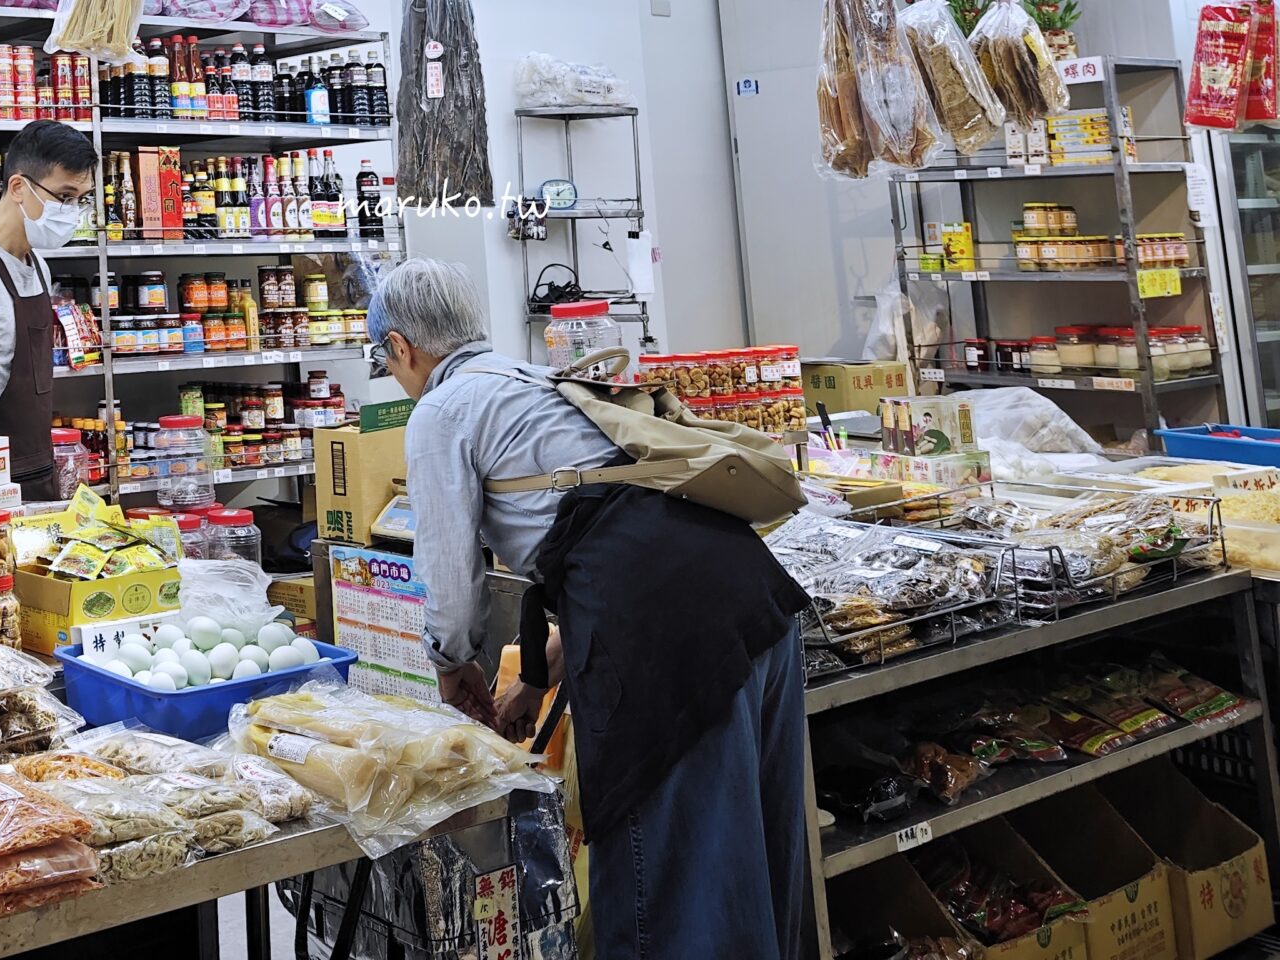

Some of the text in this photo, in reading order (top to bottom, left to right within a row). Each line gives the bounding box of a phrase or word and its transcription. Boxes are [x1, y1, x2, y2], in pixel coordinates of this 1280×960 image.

[1063, 61, 1098, 80] 螺肉
[371, 561, 410, 581] 南門市場
[371, 578, 391, 590] 2023
